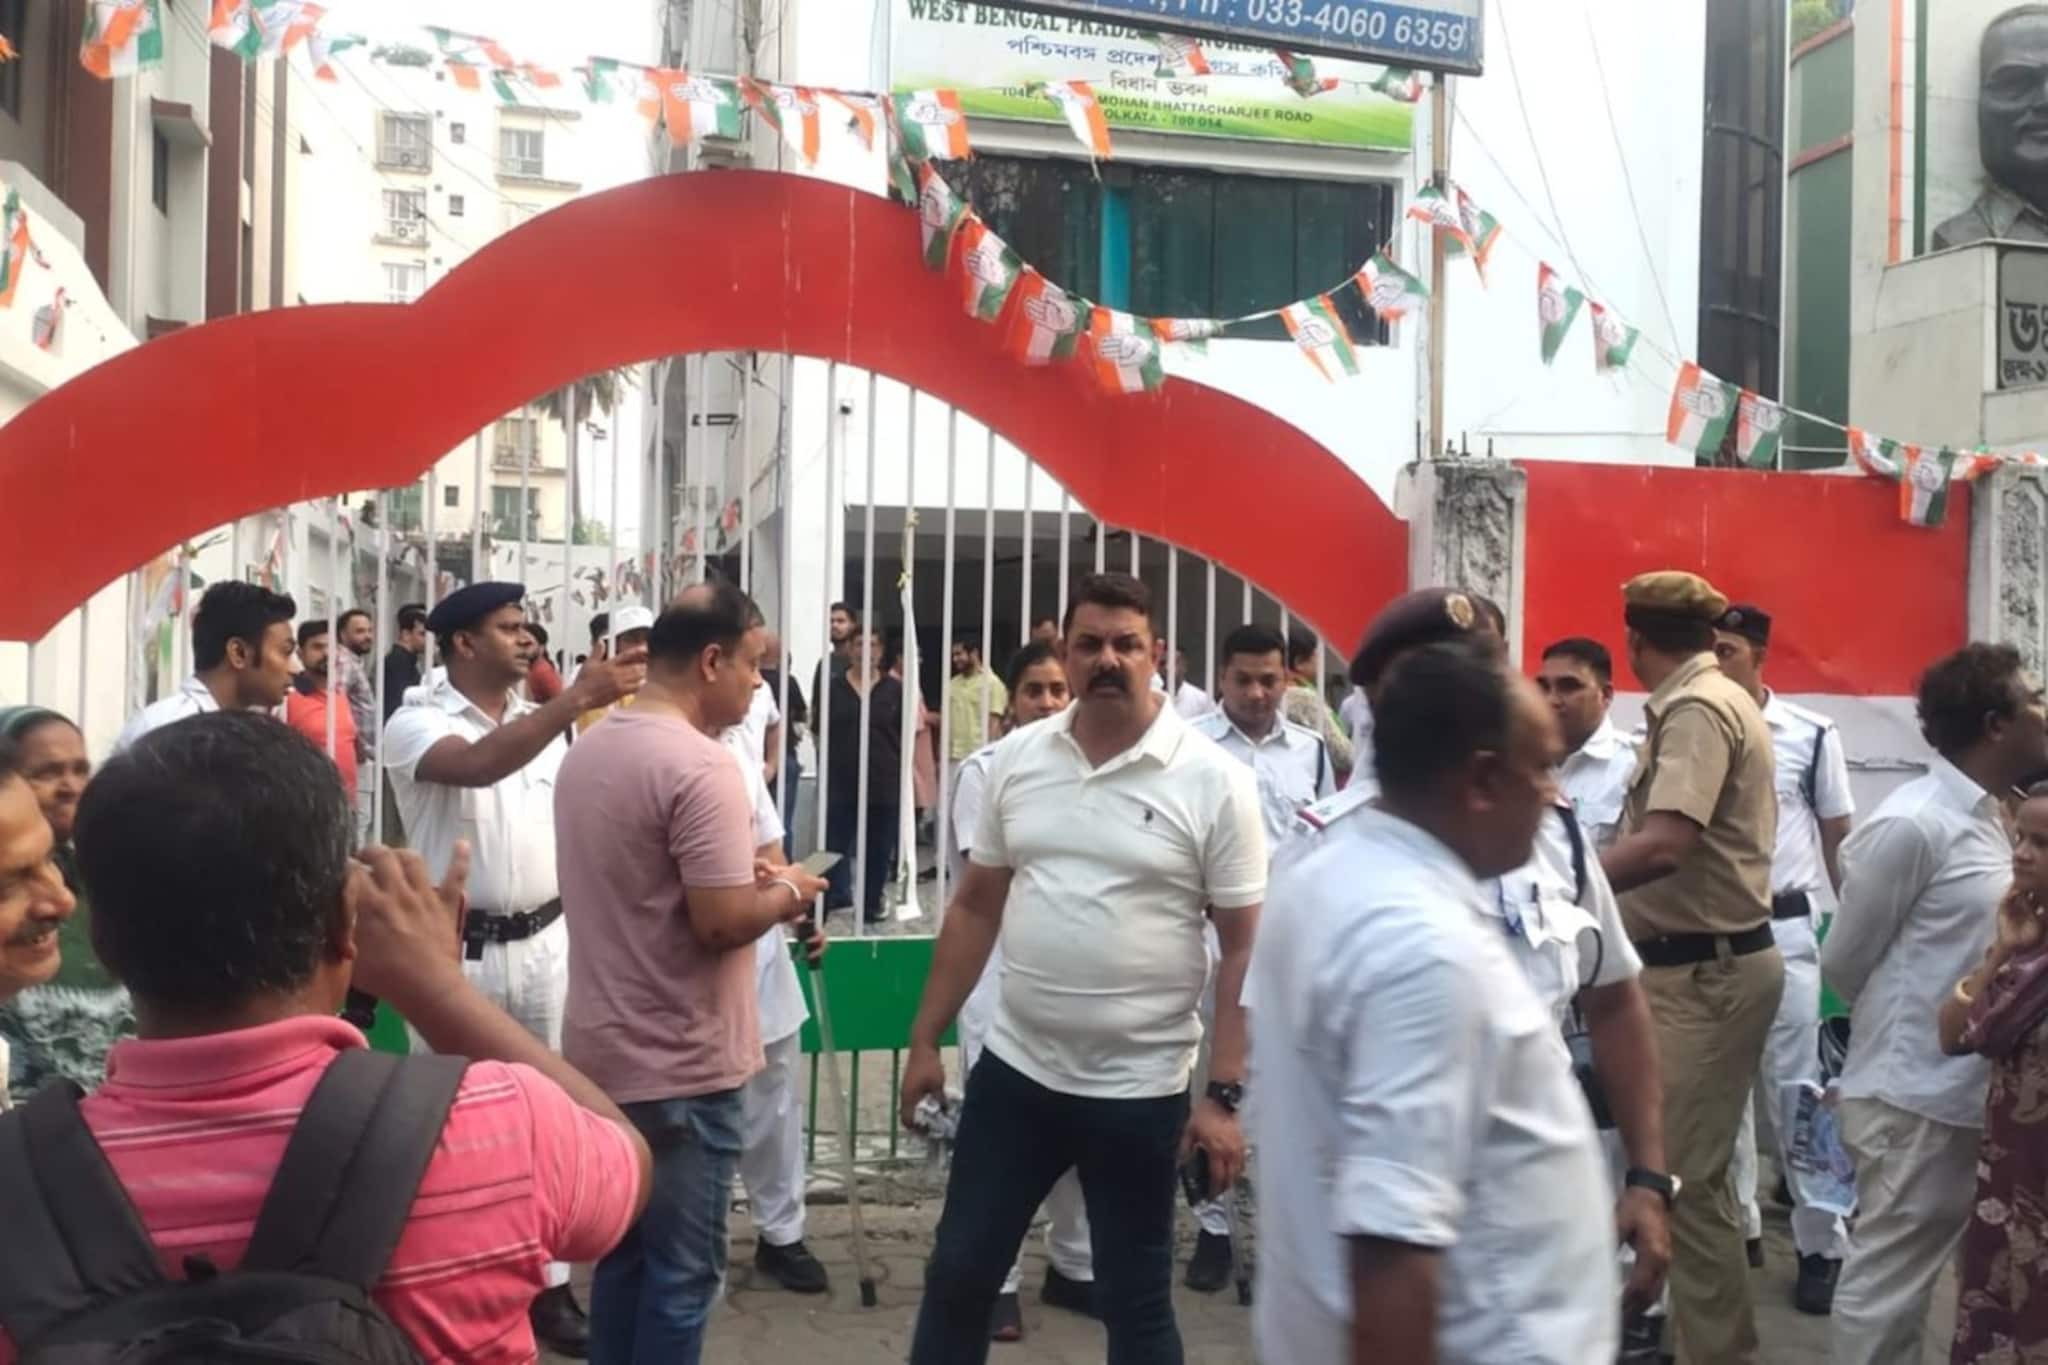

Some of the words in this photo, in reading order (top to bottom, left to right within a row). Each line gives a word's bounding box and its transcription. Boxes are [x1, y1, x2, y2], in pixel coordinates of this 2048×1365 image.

[909, 0, 969, 23] WEST
[974, 7, 1061, 32] BENGAL
[1394, 15, 1465, 50] 6359
[1110, 69, 1158, 93] বিধান
[1167, 80, 1208, 98] ভবন
[1098, 96, 1149, 109] MOHAN
[1154, 99, 1272, 120] BHATTACHARJEE
[1277, 109, 1313, 123] ROAD
[1104, 109, 1158, 124] OLKATA
